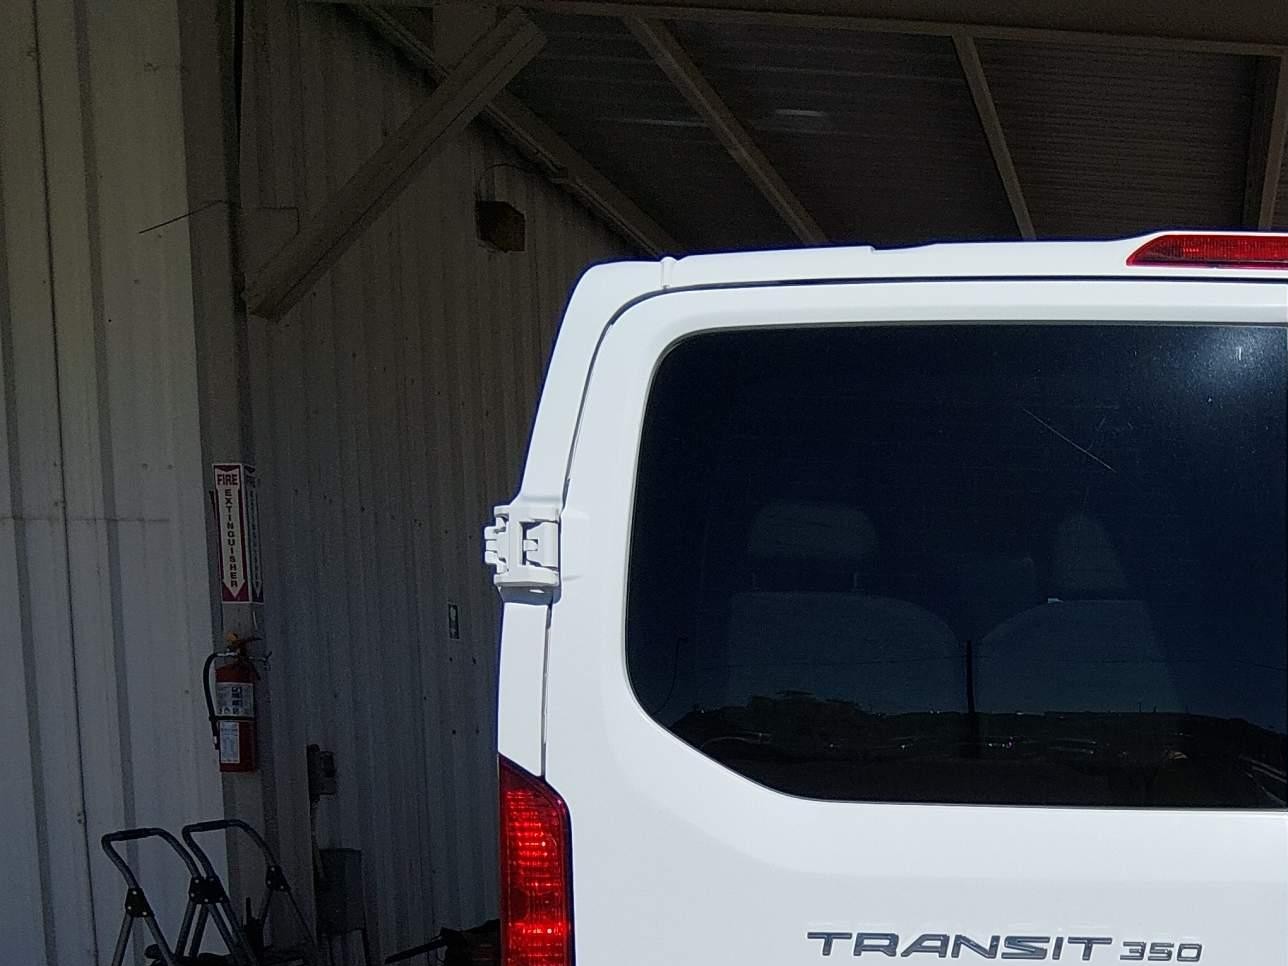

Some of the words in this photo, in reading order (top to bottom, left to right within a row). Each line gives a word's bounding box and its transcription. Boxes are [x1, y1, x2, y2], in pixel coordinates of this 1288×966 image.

[217, 474, 238, 486] FIRE
[225, 489, 238, 588] EXTINGUISHER
[807, 932, 1113, 961] TRANSIT
[1119, 941, 1202, 962] 350
